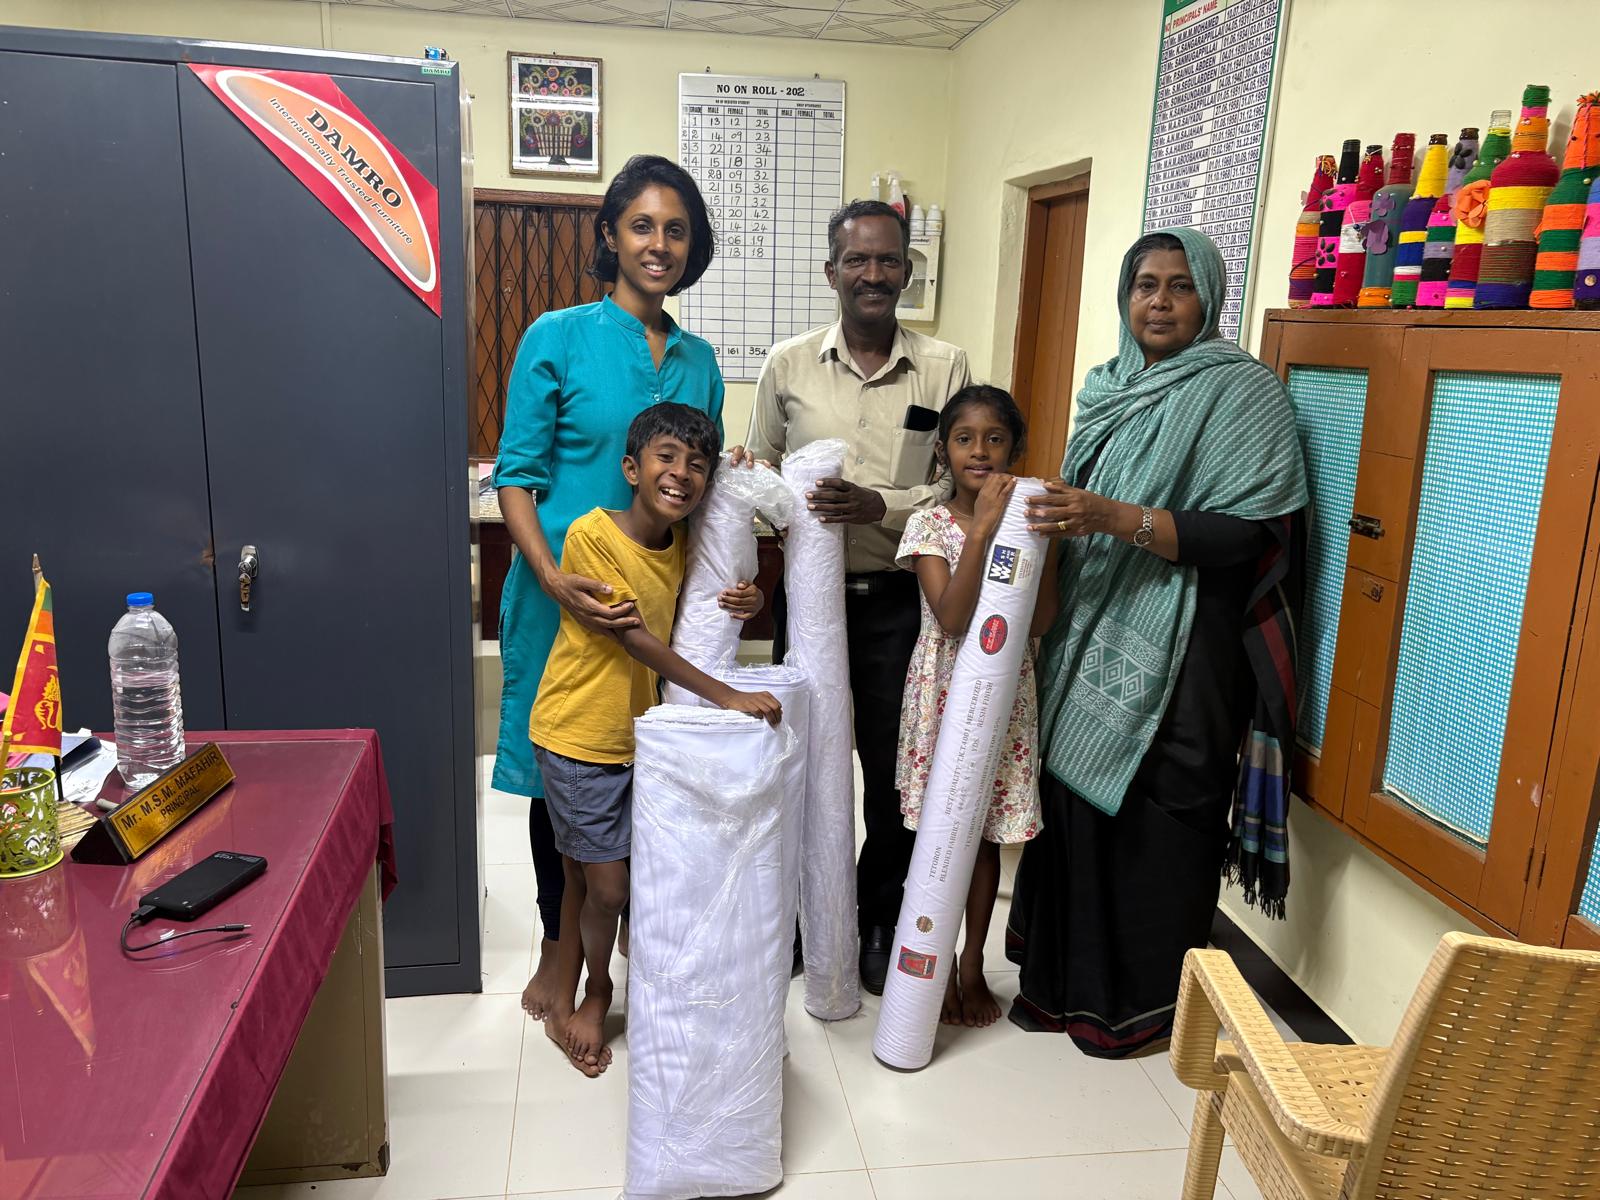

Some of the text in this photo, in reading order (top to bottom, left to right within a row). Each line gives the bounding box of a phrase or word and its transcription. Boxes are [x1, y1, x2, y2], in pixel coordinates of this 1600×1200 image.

[1173, 7, 1202, 28] PRINCIPALS'
[1203, 0, 1217, 14] NAME
[1196, 57, 1216, 71] ABDEEN
[717, 84, 730, 93] NO
[734, 86, 747, 94] ON
[752, 86, 777, 95] ROLL
[692, 130, 698, 139] 2
[712, 132, 722, 140] 14
[731, 132, 742, 141] 09
[710, 144, 723, 154] 22
[729, 145, 742, 154] 12
[755, 146, 771, 155] 34
[307, 110, 402, 209] DAMRO
[692, 156, 699, 165] 4
[710, 158, 719, 166] 15
[755, 158, 766, 167] 31
[269, 98, 412, 245] Internationally Trusted Furniture
[729, 171, 742, 180] 09
[754, 171, 768, 180] 32
[709, 183, 769, 193] 21 15 36
[710, 195, 766, 207] 15 17 32
[729, 209, 742, 217] 20
[754, 209, 769, 218] 42
[730, 222, 741, 231] 14
[752, 222, 767, 232] 24
[728, 236, 764, 245] 06 19
[752, 248, 764, 257] 18
[749, 347, 767, 356] 354
[928, 845, 941, 878] TETORON
[948, 765, 961, 795] QUALITY
[966, 679, 982, 724] MERCERIZED
[939, 849, 952, 882] BLENDED
[948, 819, 960, 848] FABRICS
[976, 706, 987, 727] RESIN
[982, 681, 993, 705] FINISH
[121, 751, 220, 831] Mr. M.S.M. MAFAHIR
[160, 783, 200, 819] PRINCIPAL
